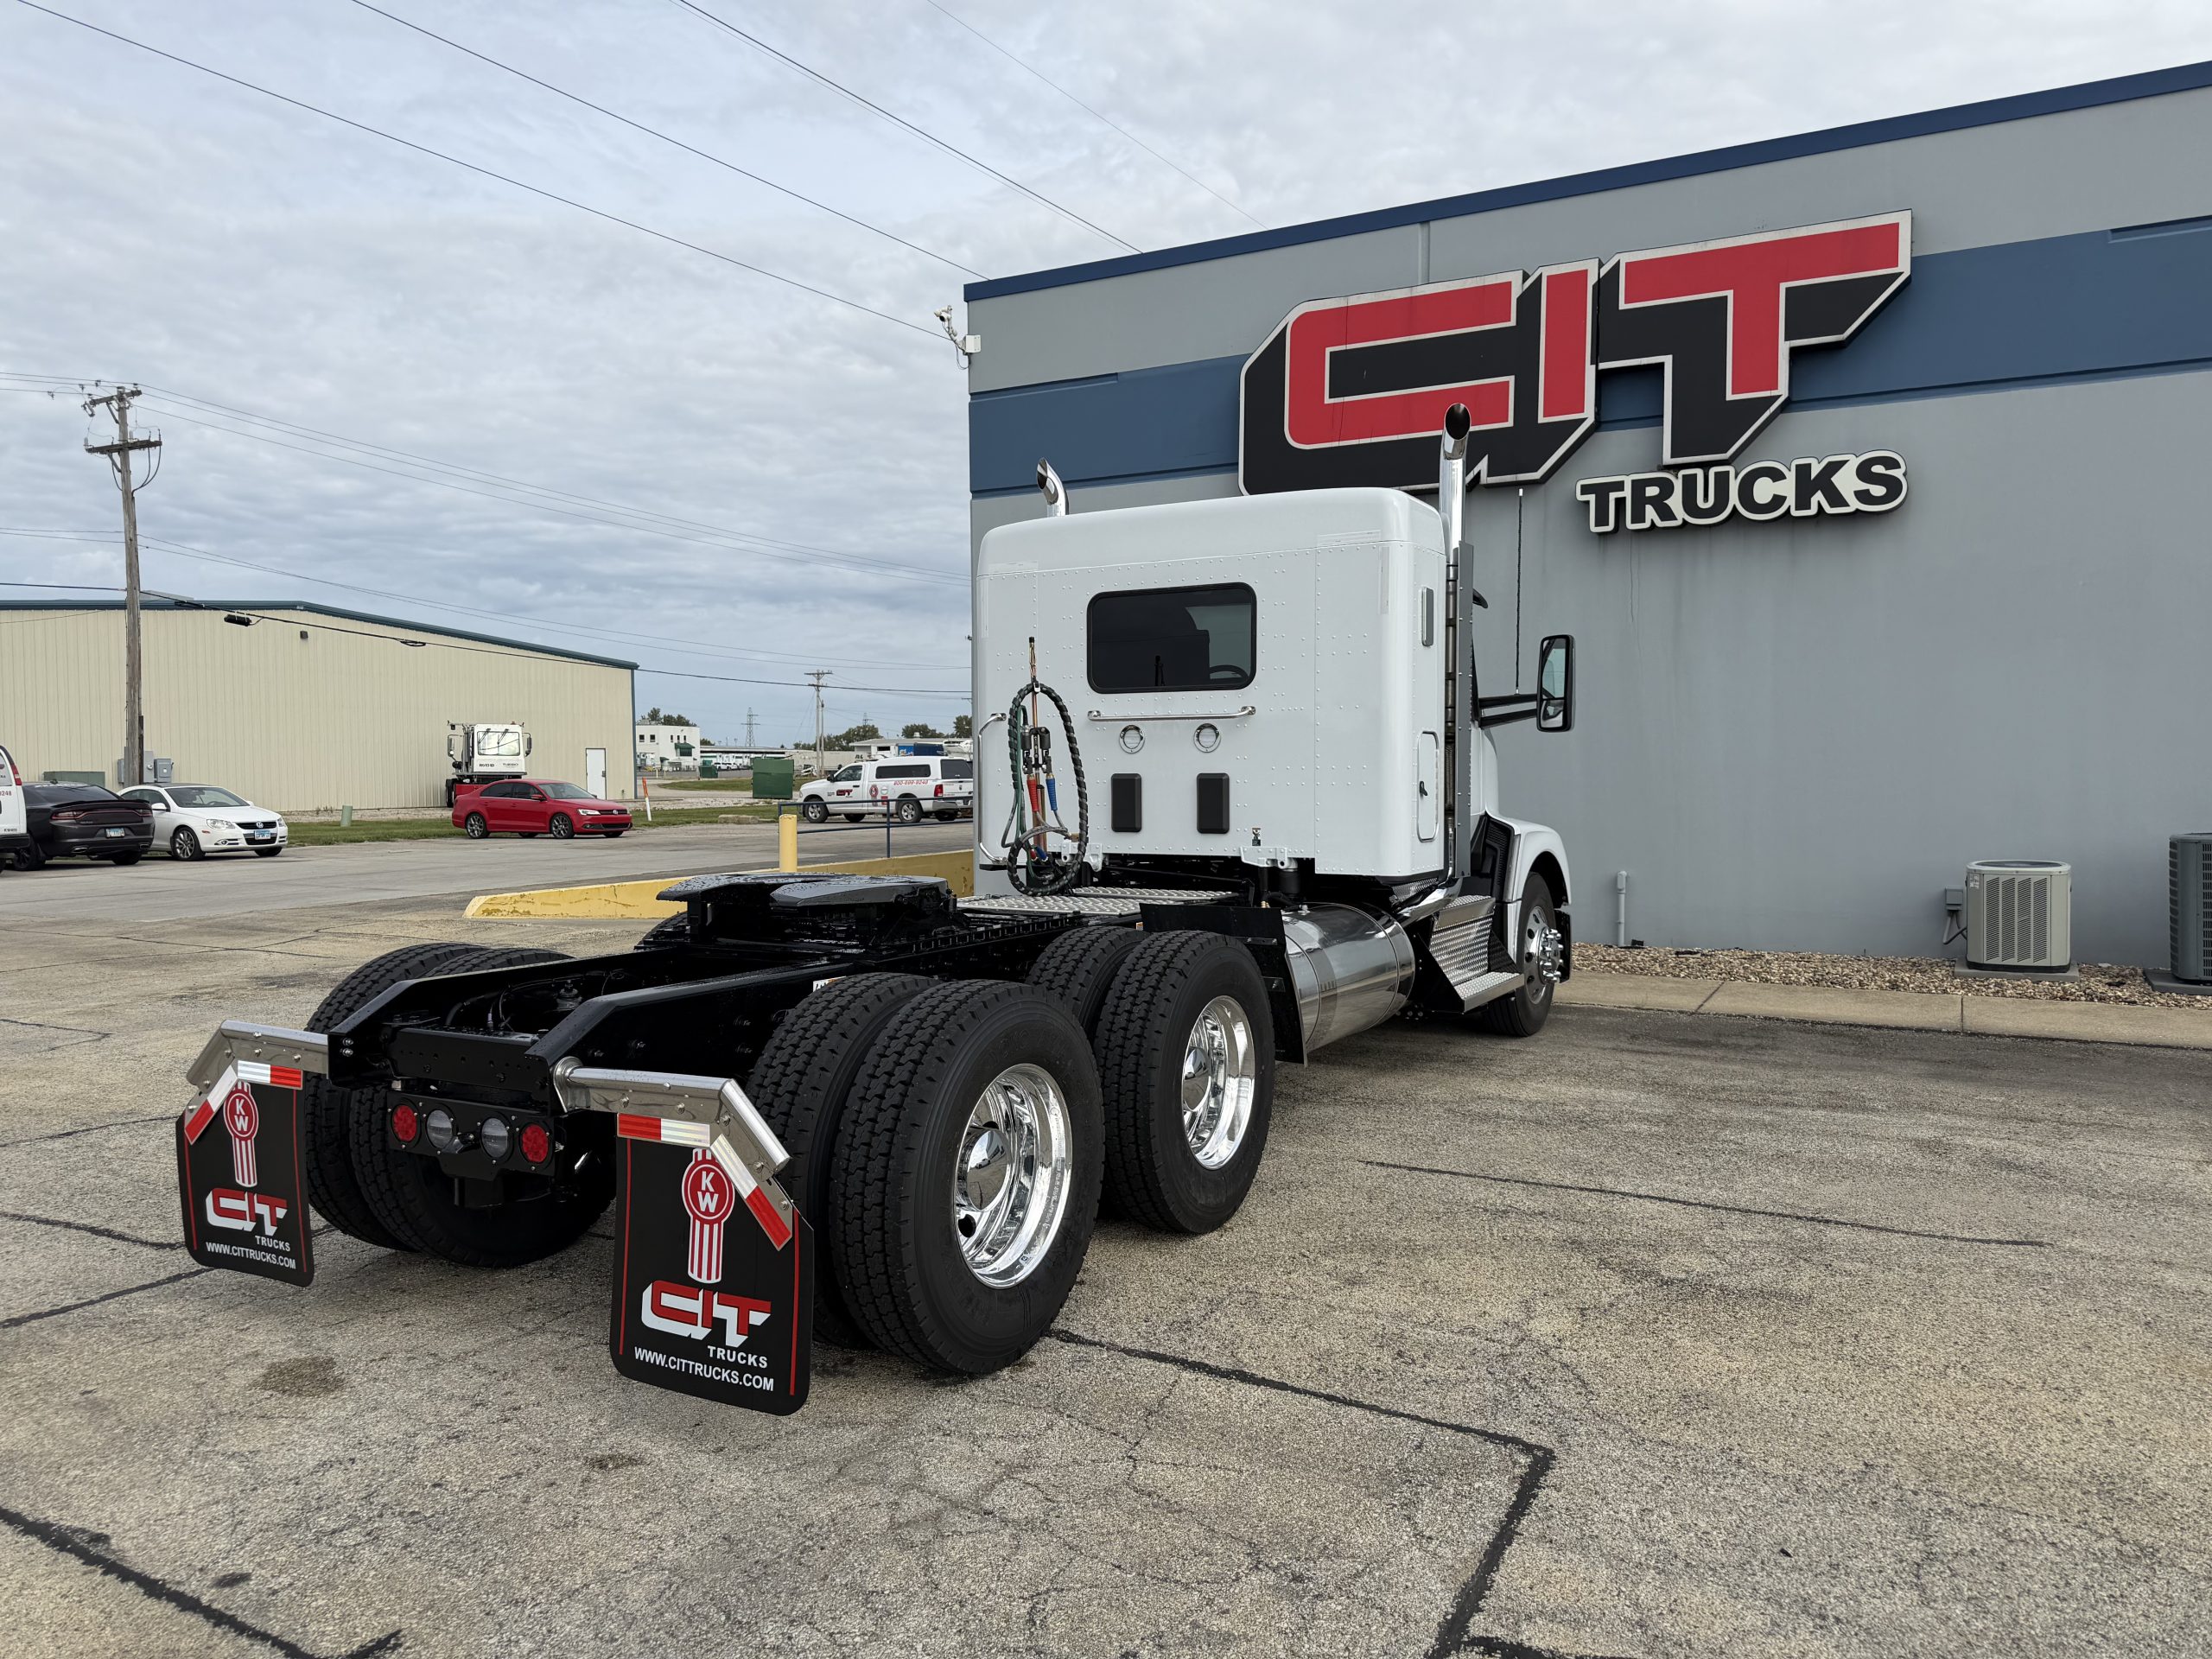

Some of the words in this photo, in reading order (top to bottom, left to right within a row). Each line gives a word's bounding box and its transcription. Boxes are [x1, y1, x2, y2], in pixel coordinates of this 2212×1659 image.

[1279, 211, 1911, 458] CIT
[1577, 452, 1906, 531] TRUCKS
[207, 1188, 288, 1236] CIT
[206, 1242, 296, 1270] WWW.CITTRUCKS.COM
[255, 1235, 291, 1252] TRUCKS
[642, 1280, 772, 1347] CIT
[634, 1346, 774, 1392] WWW.CITTRUCKS.COM
[707, 1344, 768, 1369] TRUCKS
